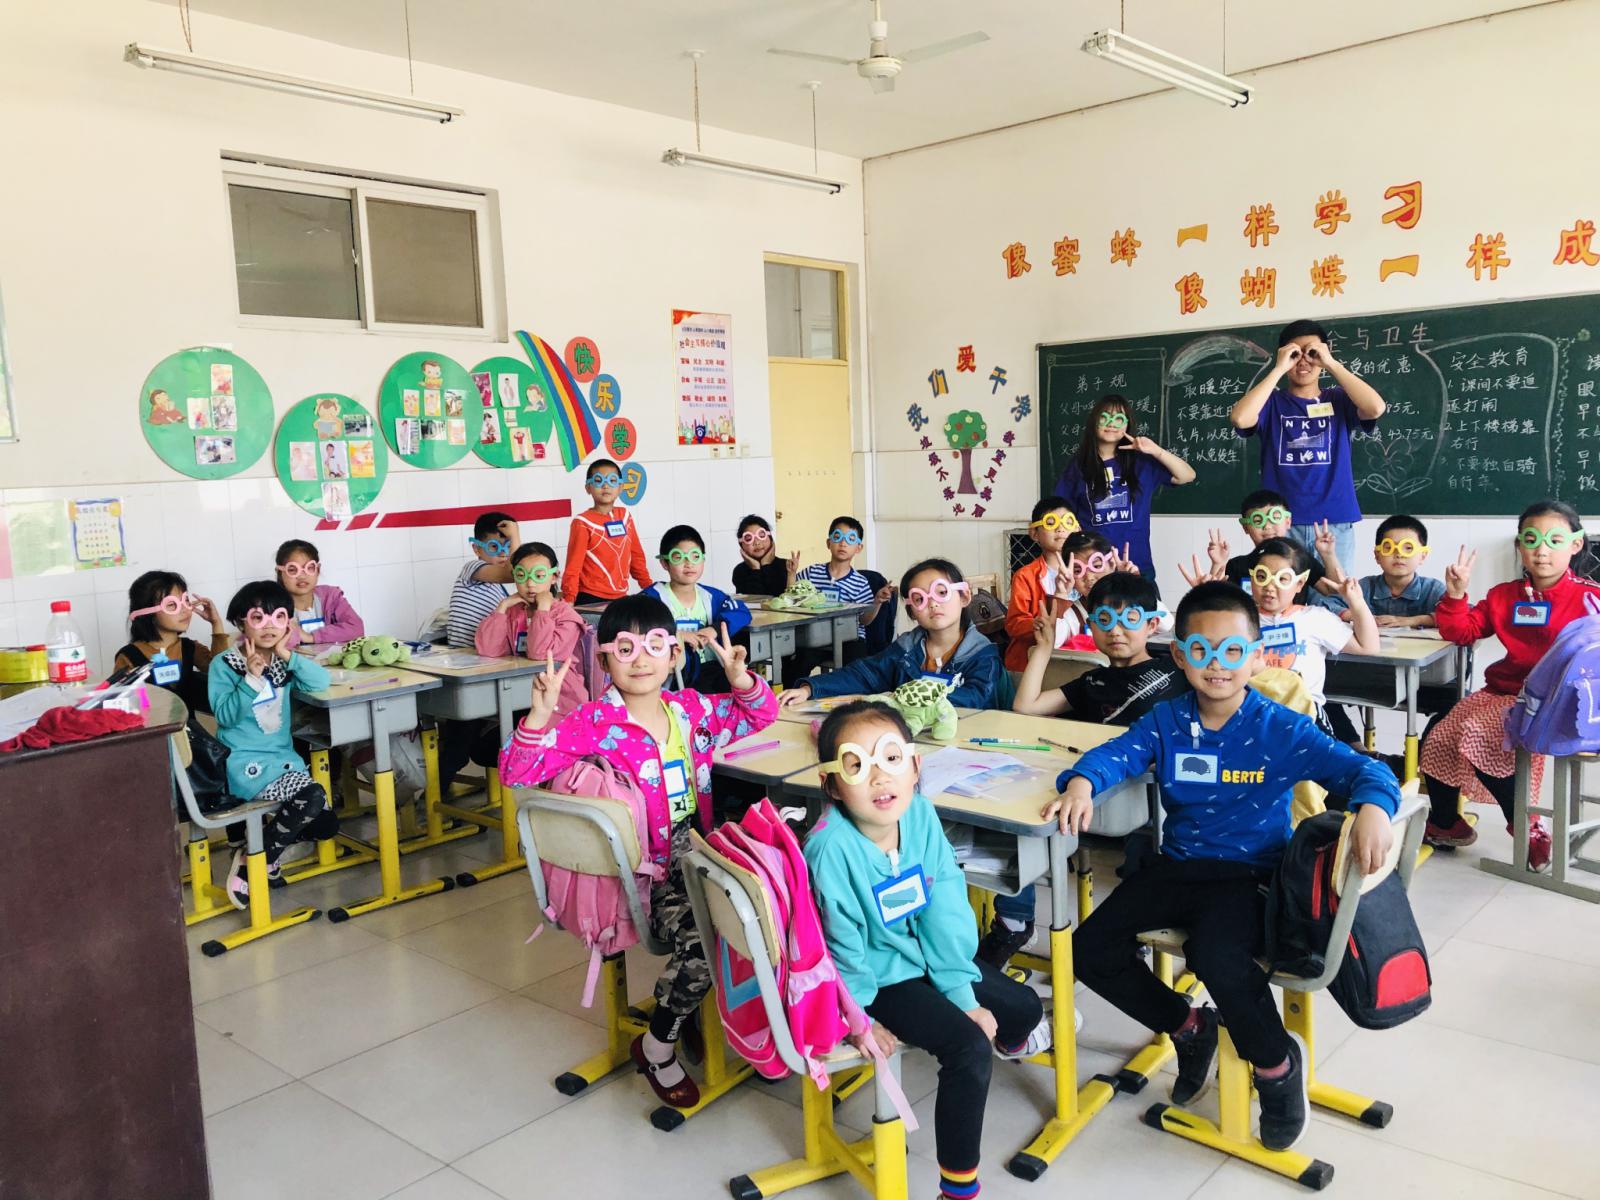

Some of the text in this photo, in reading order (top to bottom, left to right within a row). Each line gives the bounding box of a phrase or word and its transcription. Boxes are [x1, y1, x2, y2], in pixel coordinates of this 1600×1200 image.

[1002, 181, 1422, 279] 像蜜蜂一样学习
[1450, 346, 1528, 371] 安全教育
[1076, 373, 1127, 394] 弟子规
[1183, 377, 1247, 399] 取暖安全
[574, 342, 642, 498] 快乐学习
